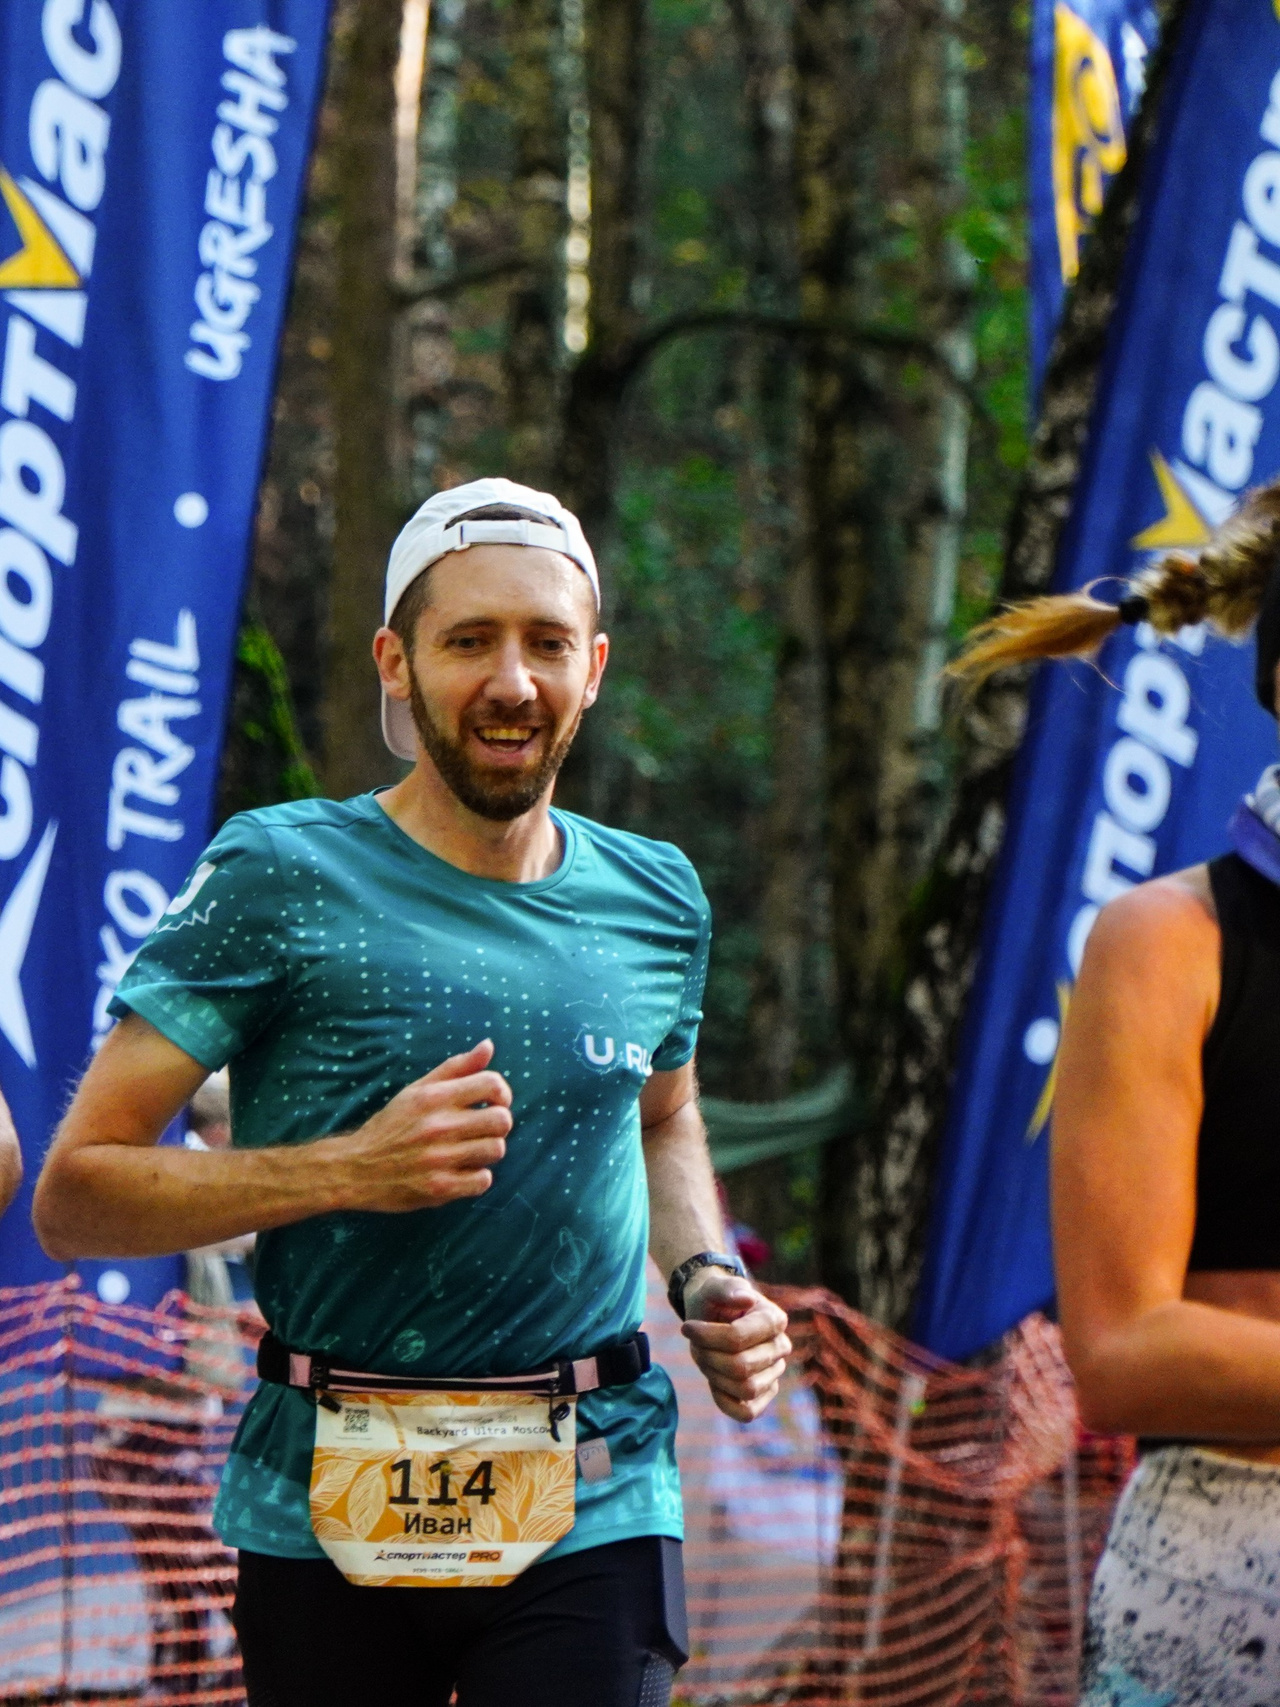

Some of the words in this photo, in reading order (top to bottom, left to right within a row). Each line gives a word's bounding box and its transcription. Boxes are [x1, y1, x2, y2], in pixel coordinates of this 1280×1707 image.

[184, 22, 298, 381] UGRESHA
[107, 608, 202, 851] TRAIL
[584, 1034, 614, 1066] U
[416, 1425, 468, 1438] Backyard
[474, 1425, 507, 1436] Ultra
[389, 1459, 496, 1506] 114
[404, 1512, 472, 1535] Иван
[469, 1551, 500, 1561] PRO
